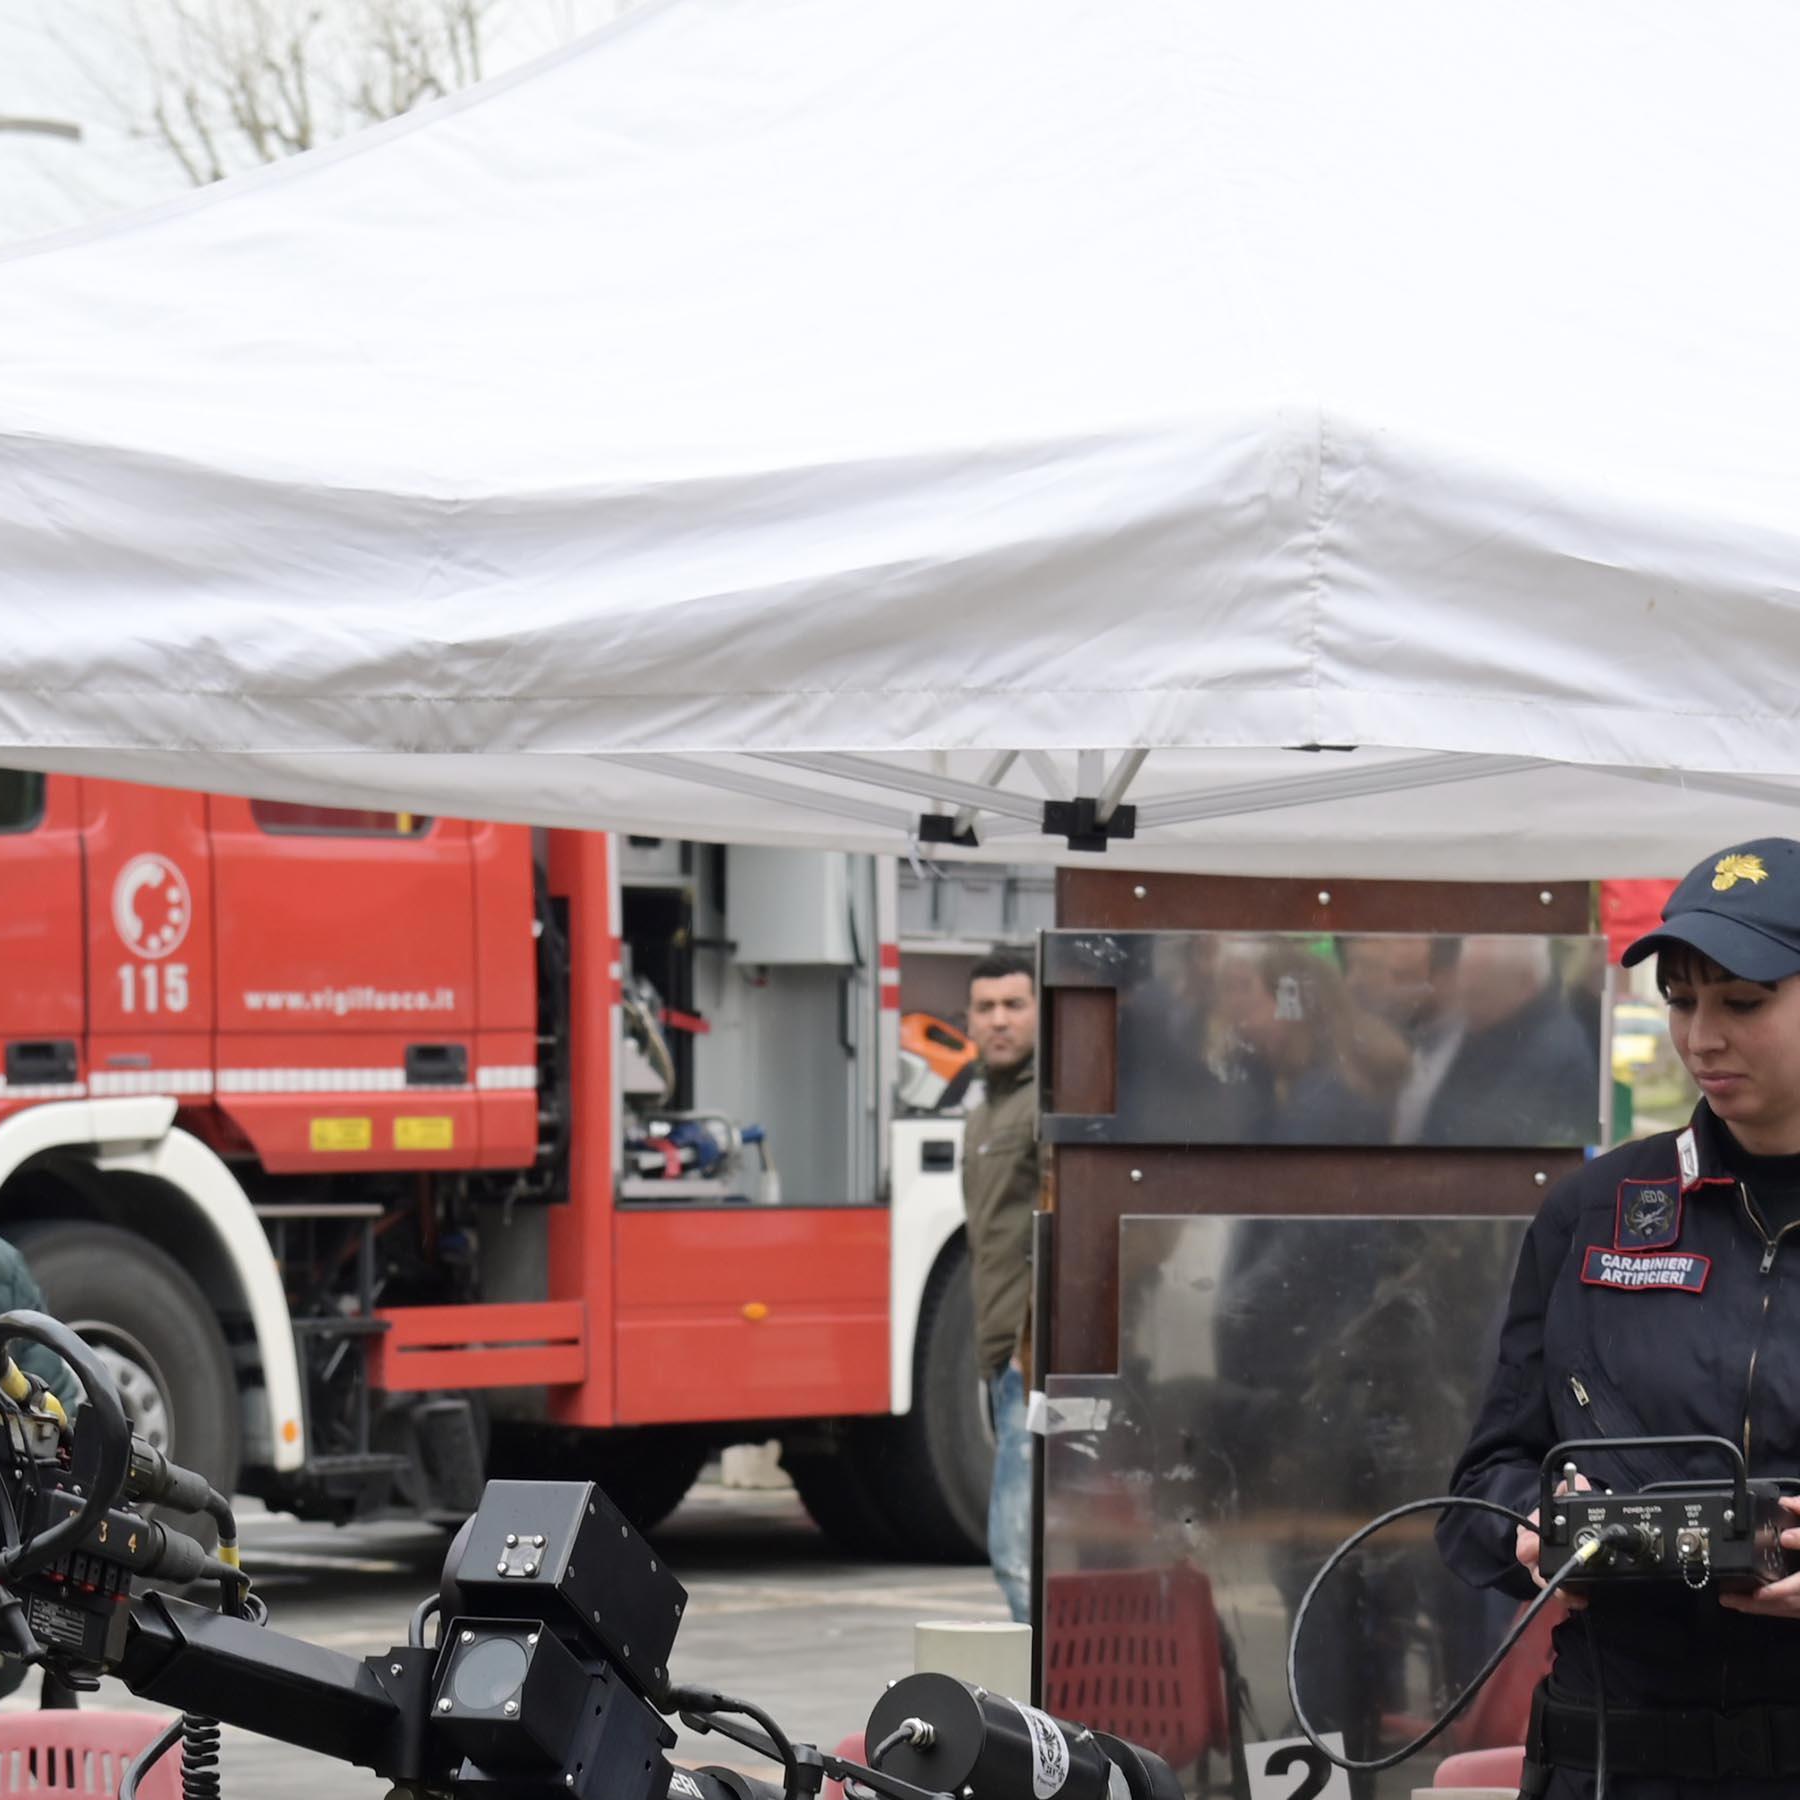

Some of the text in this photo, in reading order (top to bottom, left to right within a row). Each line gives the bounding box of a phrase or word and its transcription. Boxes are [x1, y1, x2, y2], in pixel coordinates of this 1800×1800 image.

[119, 963, 189, 1014] 115
[243, 985, 455, 1016] www.vigilfuoco.it
[1599, 1269, 1686, 1286] ARTIFICIERI
[1600, 1253, 1694, 1273] CARABINIERI
[98, 1520, 138, 1554] 3 4
